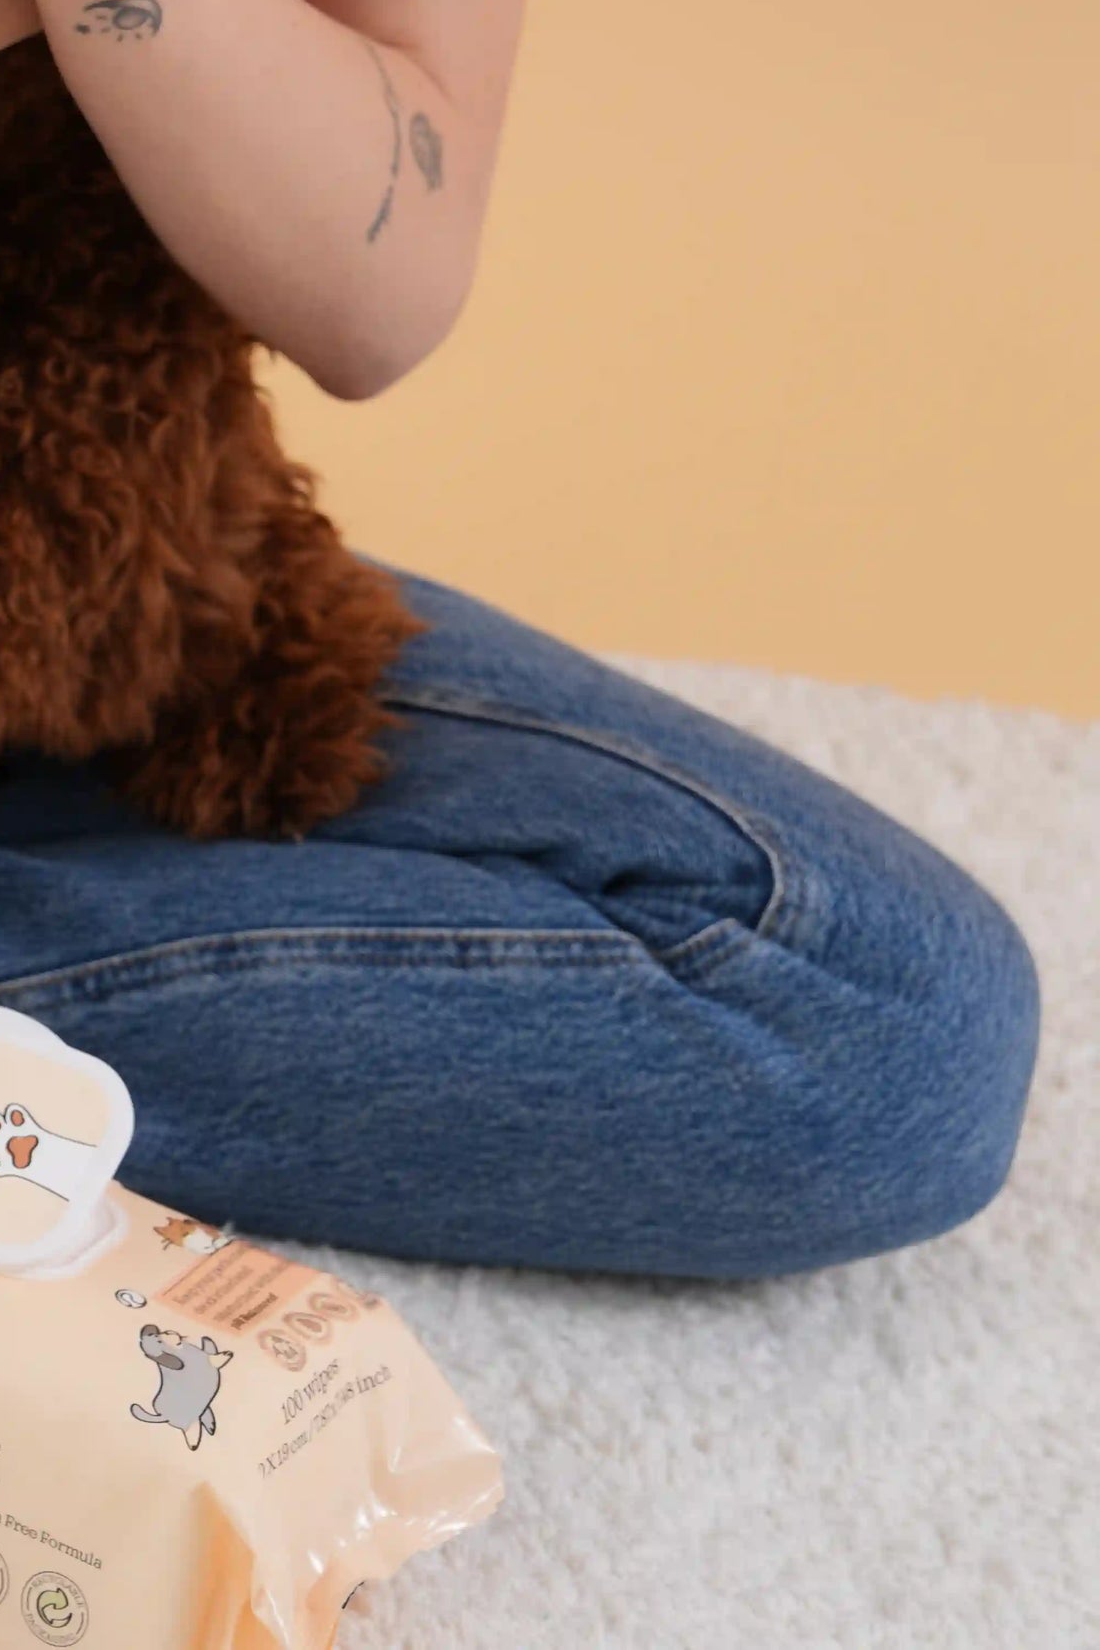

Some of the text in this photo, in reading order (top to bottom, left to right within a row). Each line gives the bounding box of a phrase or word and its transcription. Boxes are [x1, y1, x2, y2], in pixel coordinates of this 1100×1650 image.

[281, 1358, 339, 1425] 100 wipes
[4, 1514, 39, 1539] Free
[39, 1530, 103, 1569] Formula
